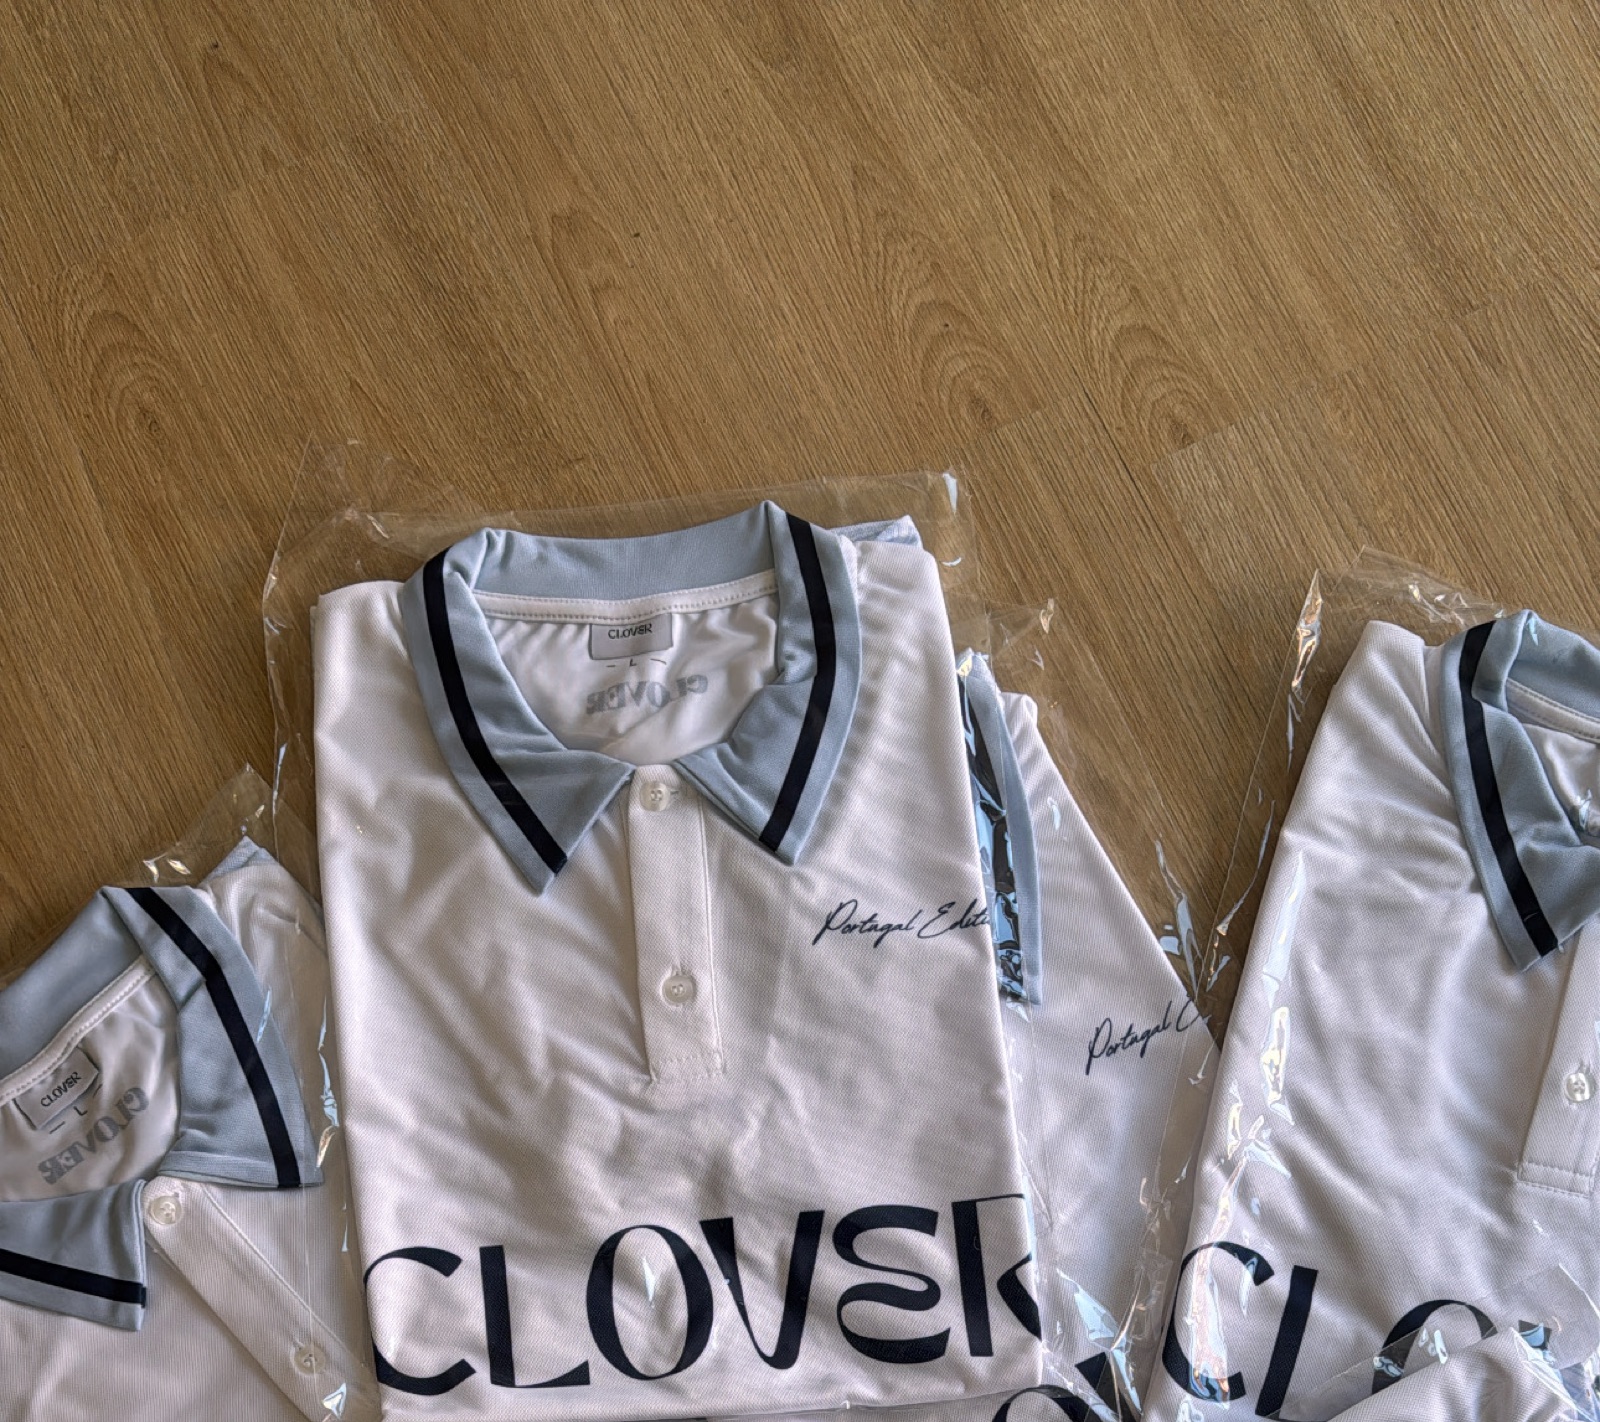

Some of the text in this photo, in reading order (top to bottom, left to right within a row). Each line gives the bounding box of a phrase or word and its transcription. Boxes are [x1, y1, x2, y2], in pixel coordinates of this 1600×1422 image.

[607, 623, 653, 640] CLOVER
[812, 899, 923, 949] Portugal
[1085, 1000, 1172, 1076] Portugal
[40, 1071, 82, 1108] CLOVER
[73, 1105, 88, 1117] L
